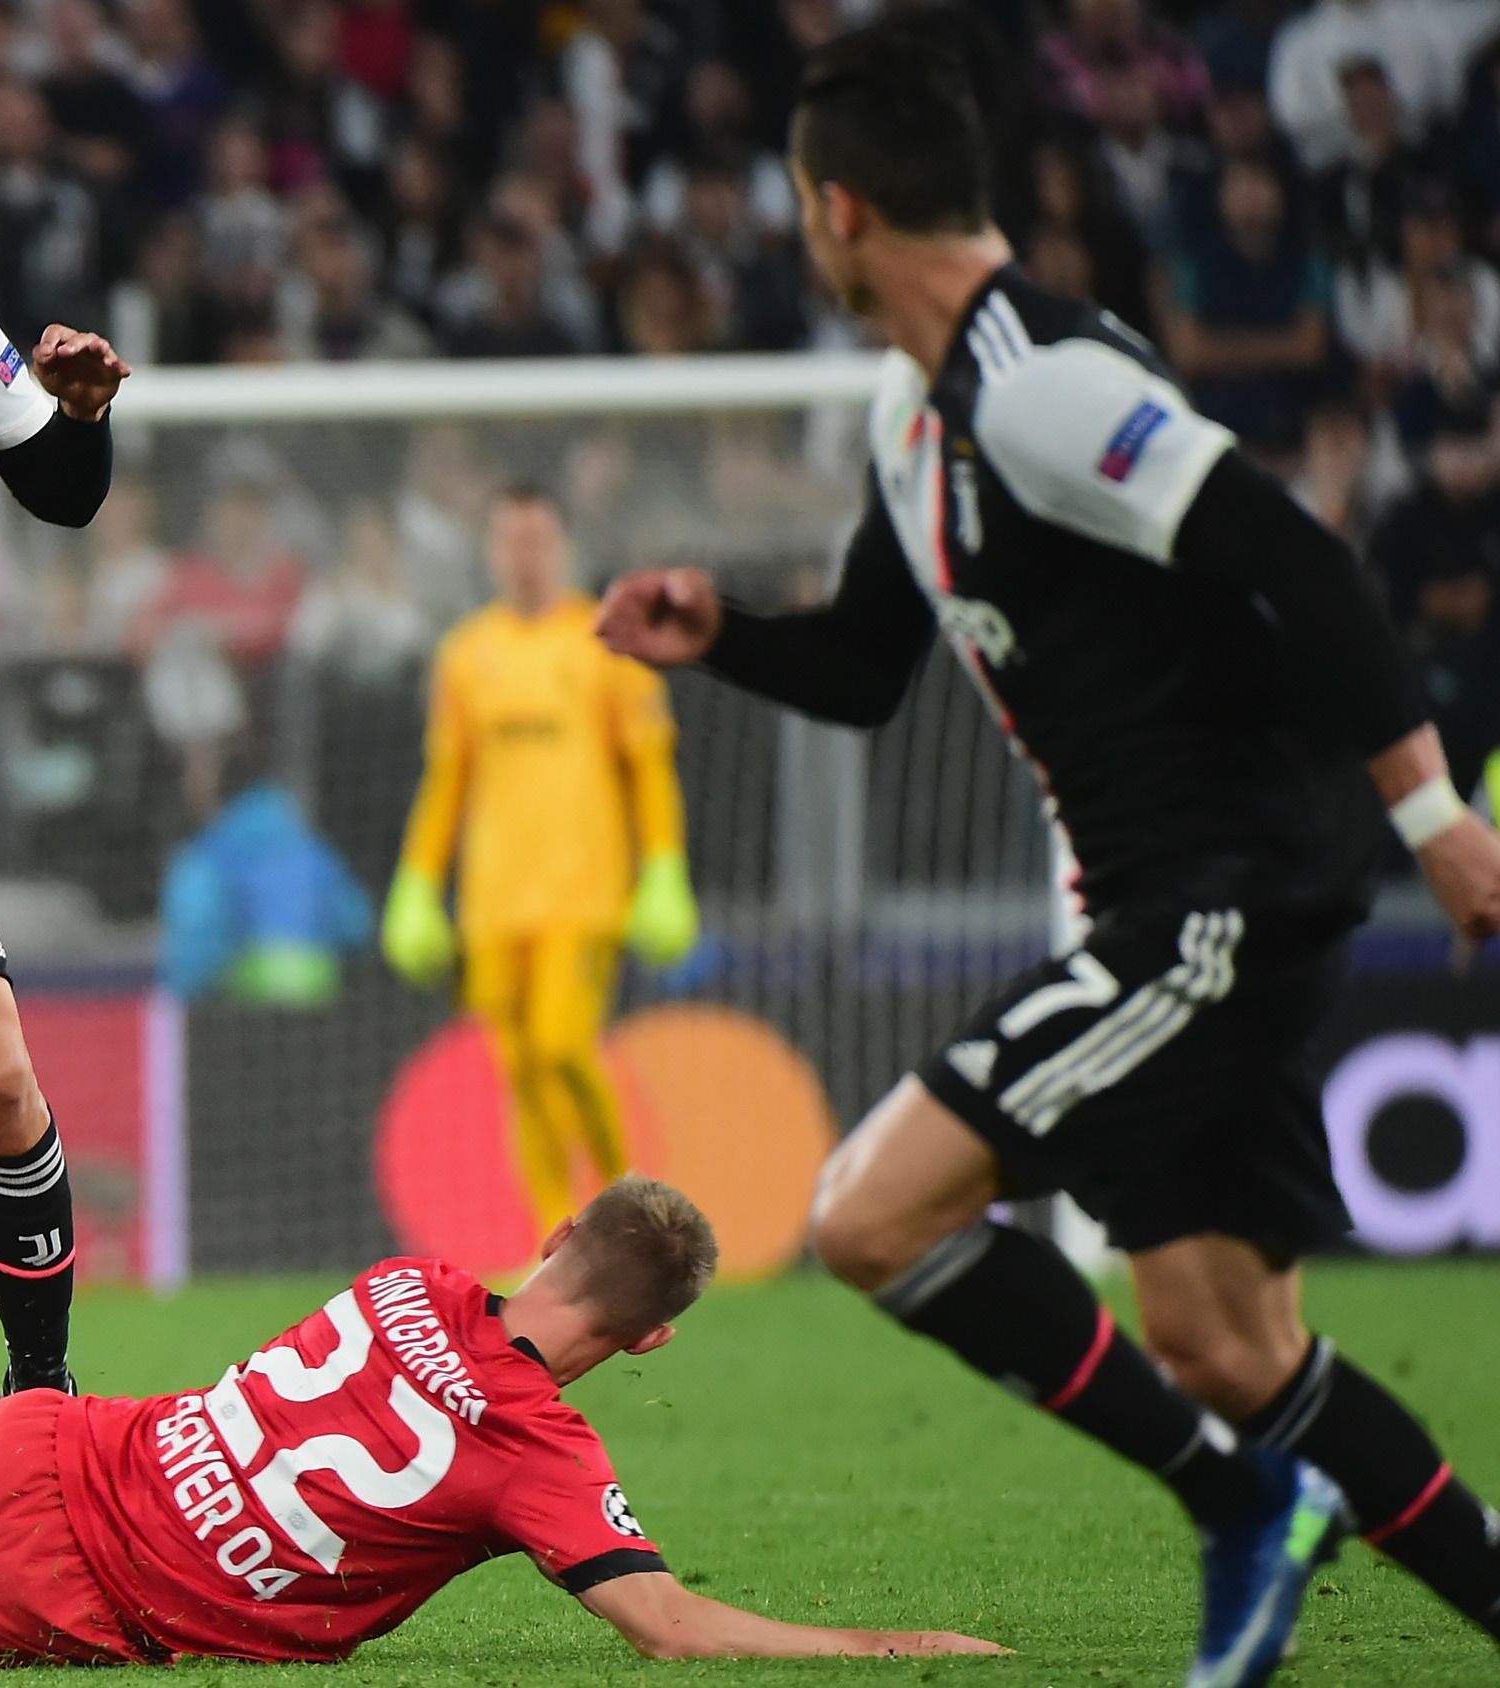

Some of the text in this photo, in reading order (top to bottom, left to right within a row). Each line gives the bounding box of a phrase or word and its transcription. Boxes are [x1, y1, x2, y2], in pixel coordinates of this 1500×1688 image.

[997, 951, 1121, 1040] 7
[156, 1395, 244, 1541] BAYER
[203, 1287, 456, 1575] 22
